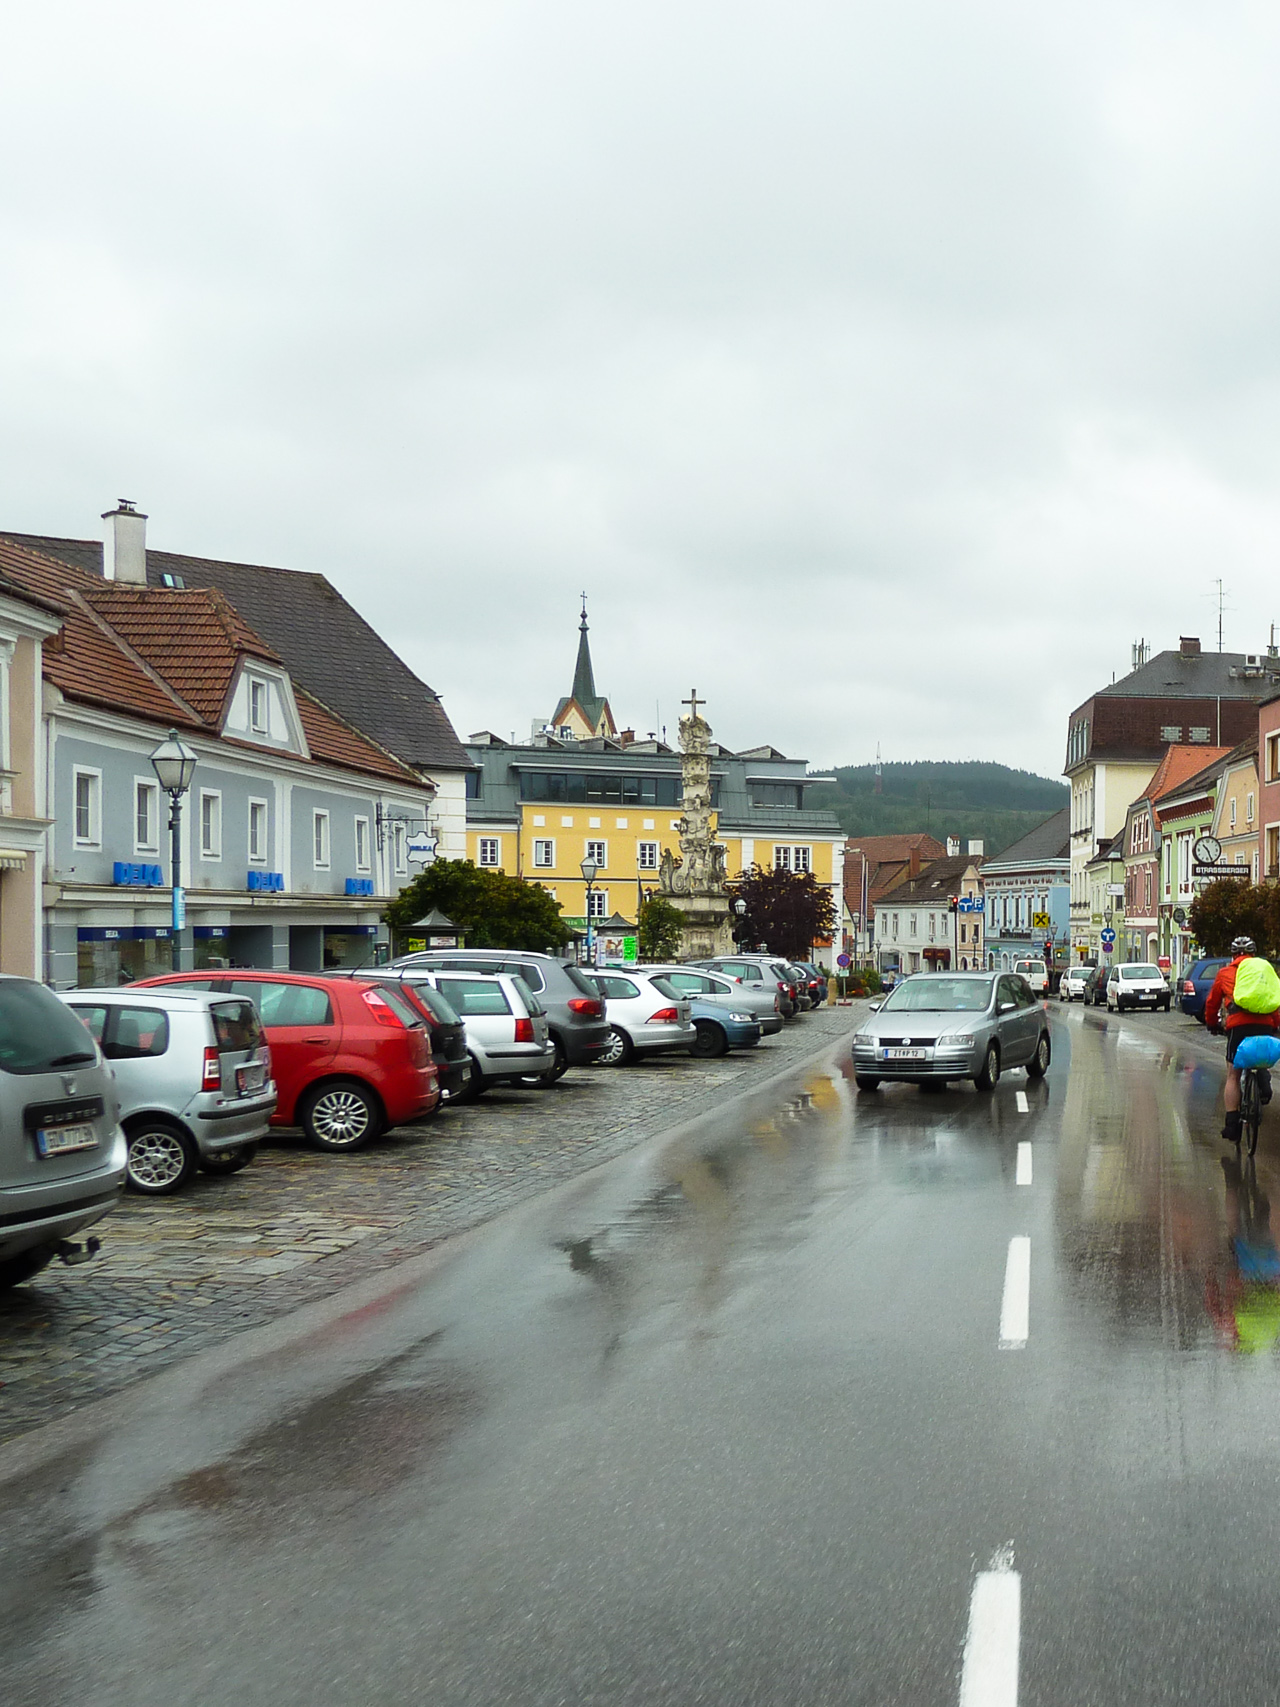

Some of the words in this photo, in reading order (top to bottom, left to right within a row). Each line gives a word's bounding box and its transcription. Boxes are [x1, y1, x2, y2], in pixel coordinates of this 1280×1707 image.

[114, 861, 164, 886] DELKA
[1195, 866, 1249, 874] STRASSBERGER
[247, 871, 285, 892] DELKA
[345, 878, 374, 896] DELKA
[44, 1107, 98, 1123] DUSTER
